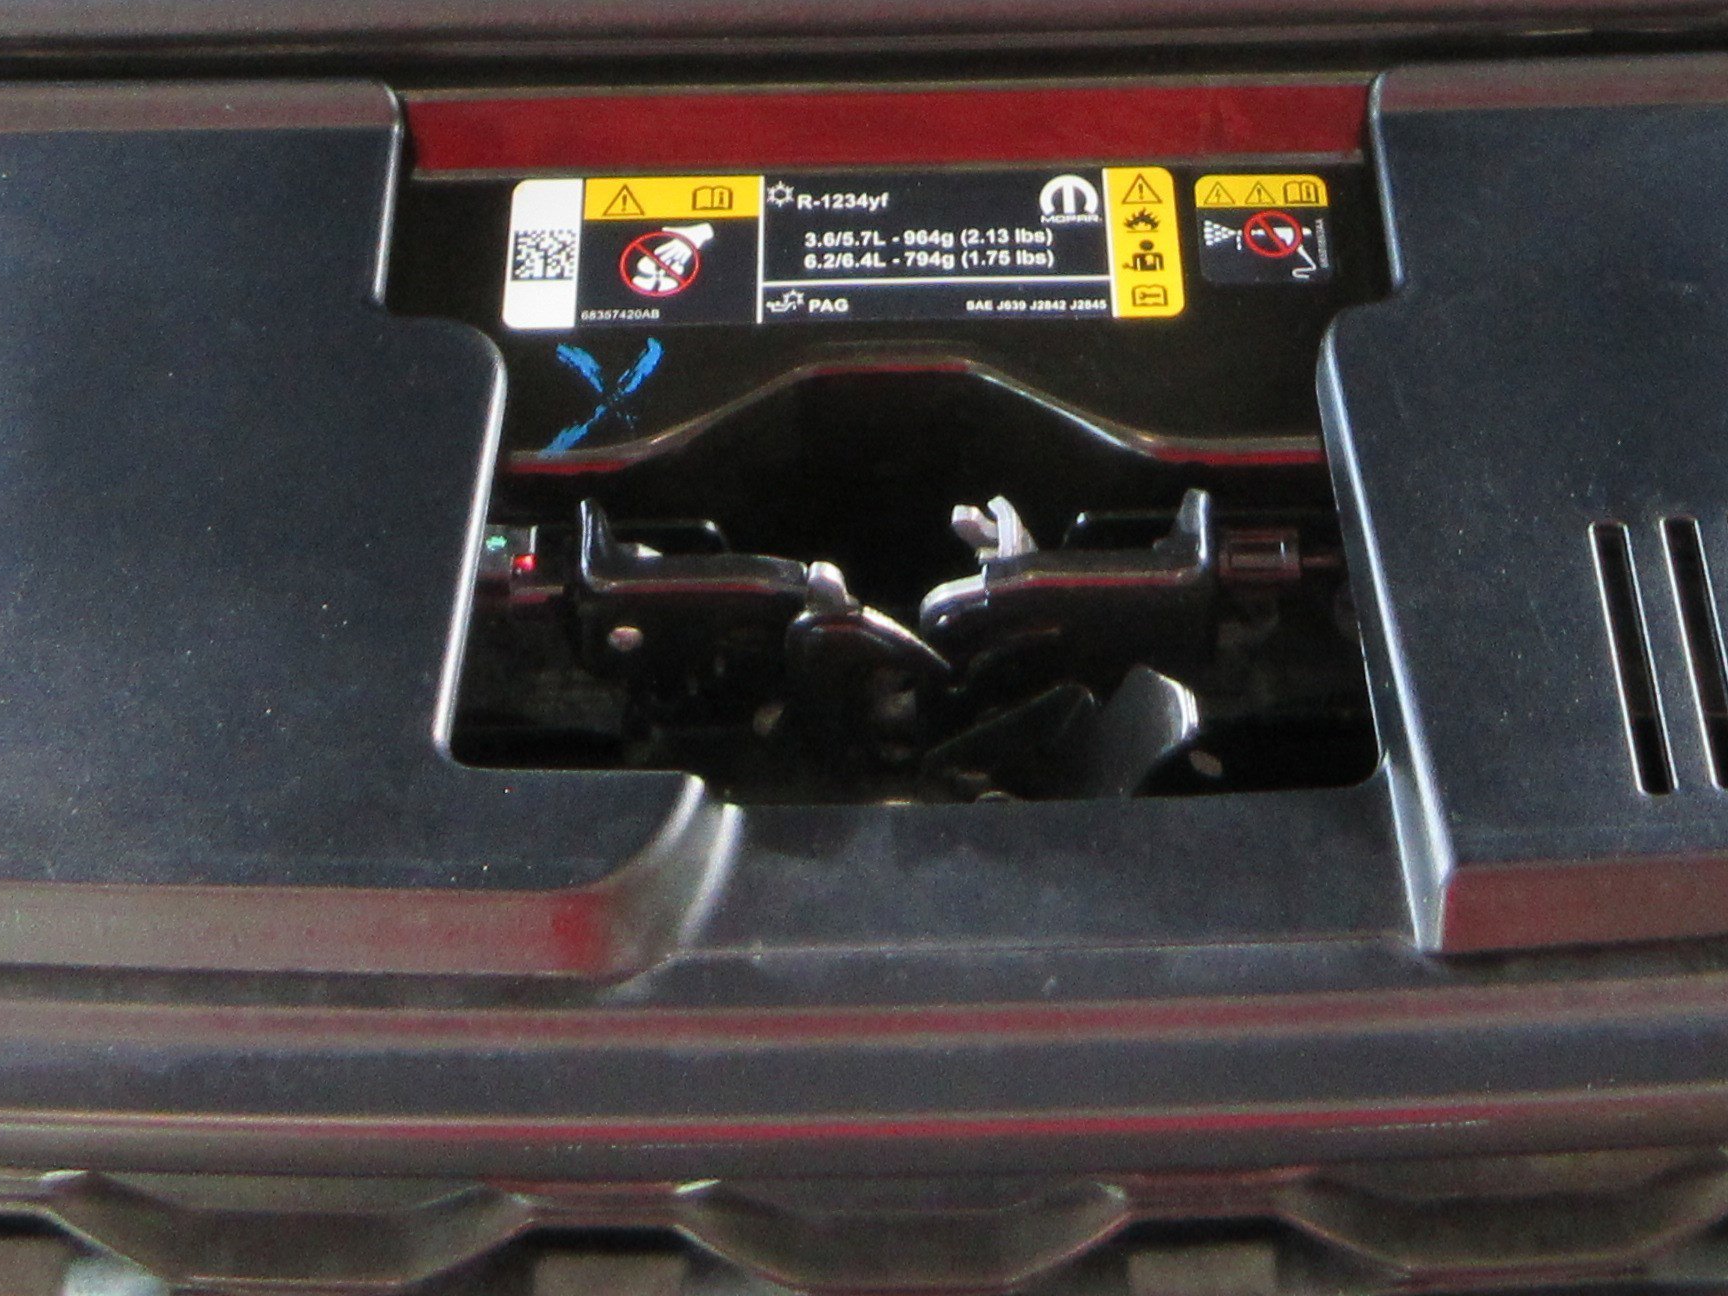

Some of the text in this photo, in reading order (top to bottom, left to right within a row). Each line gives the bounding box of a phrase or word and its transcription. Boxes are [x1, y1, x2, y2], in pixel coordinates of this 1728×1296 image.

[797, 193, 889, 212] R-1234yf
[805, 231, 886, 248] 3.6/5.7L
[904, 230, 954, 248] 964g
[960, 229, 1009, 247] (2.13
[1015, 228, 1054, 246] lbs)
[804, 252, 887, 270] 6.2/6.4L
[904, 251, 956, 270] 794g
[961, 250, 1011, 268] (1.75
[1016, 250, 1055, 268] lbs)
[808, 299, 849, 313] PAG
[966, 299, 1108, 311] SAE J639 J2842 J2845
[581, 309, 660, 320] 68357420AB
